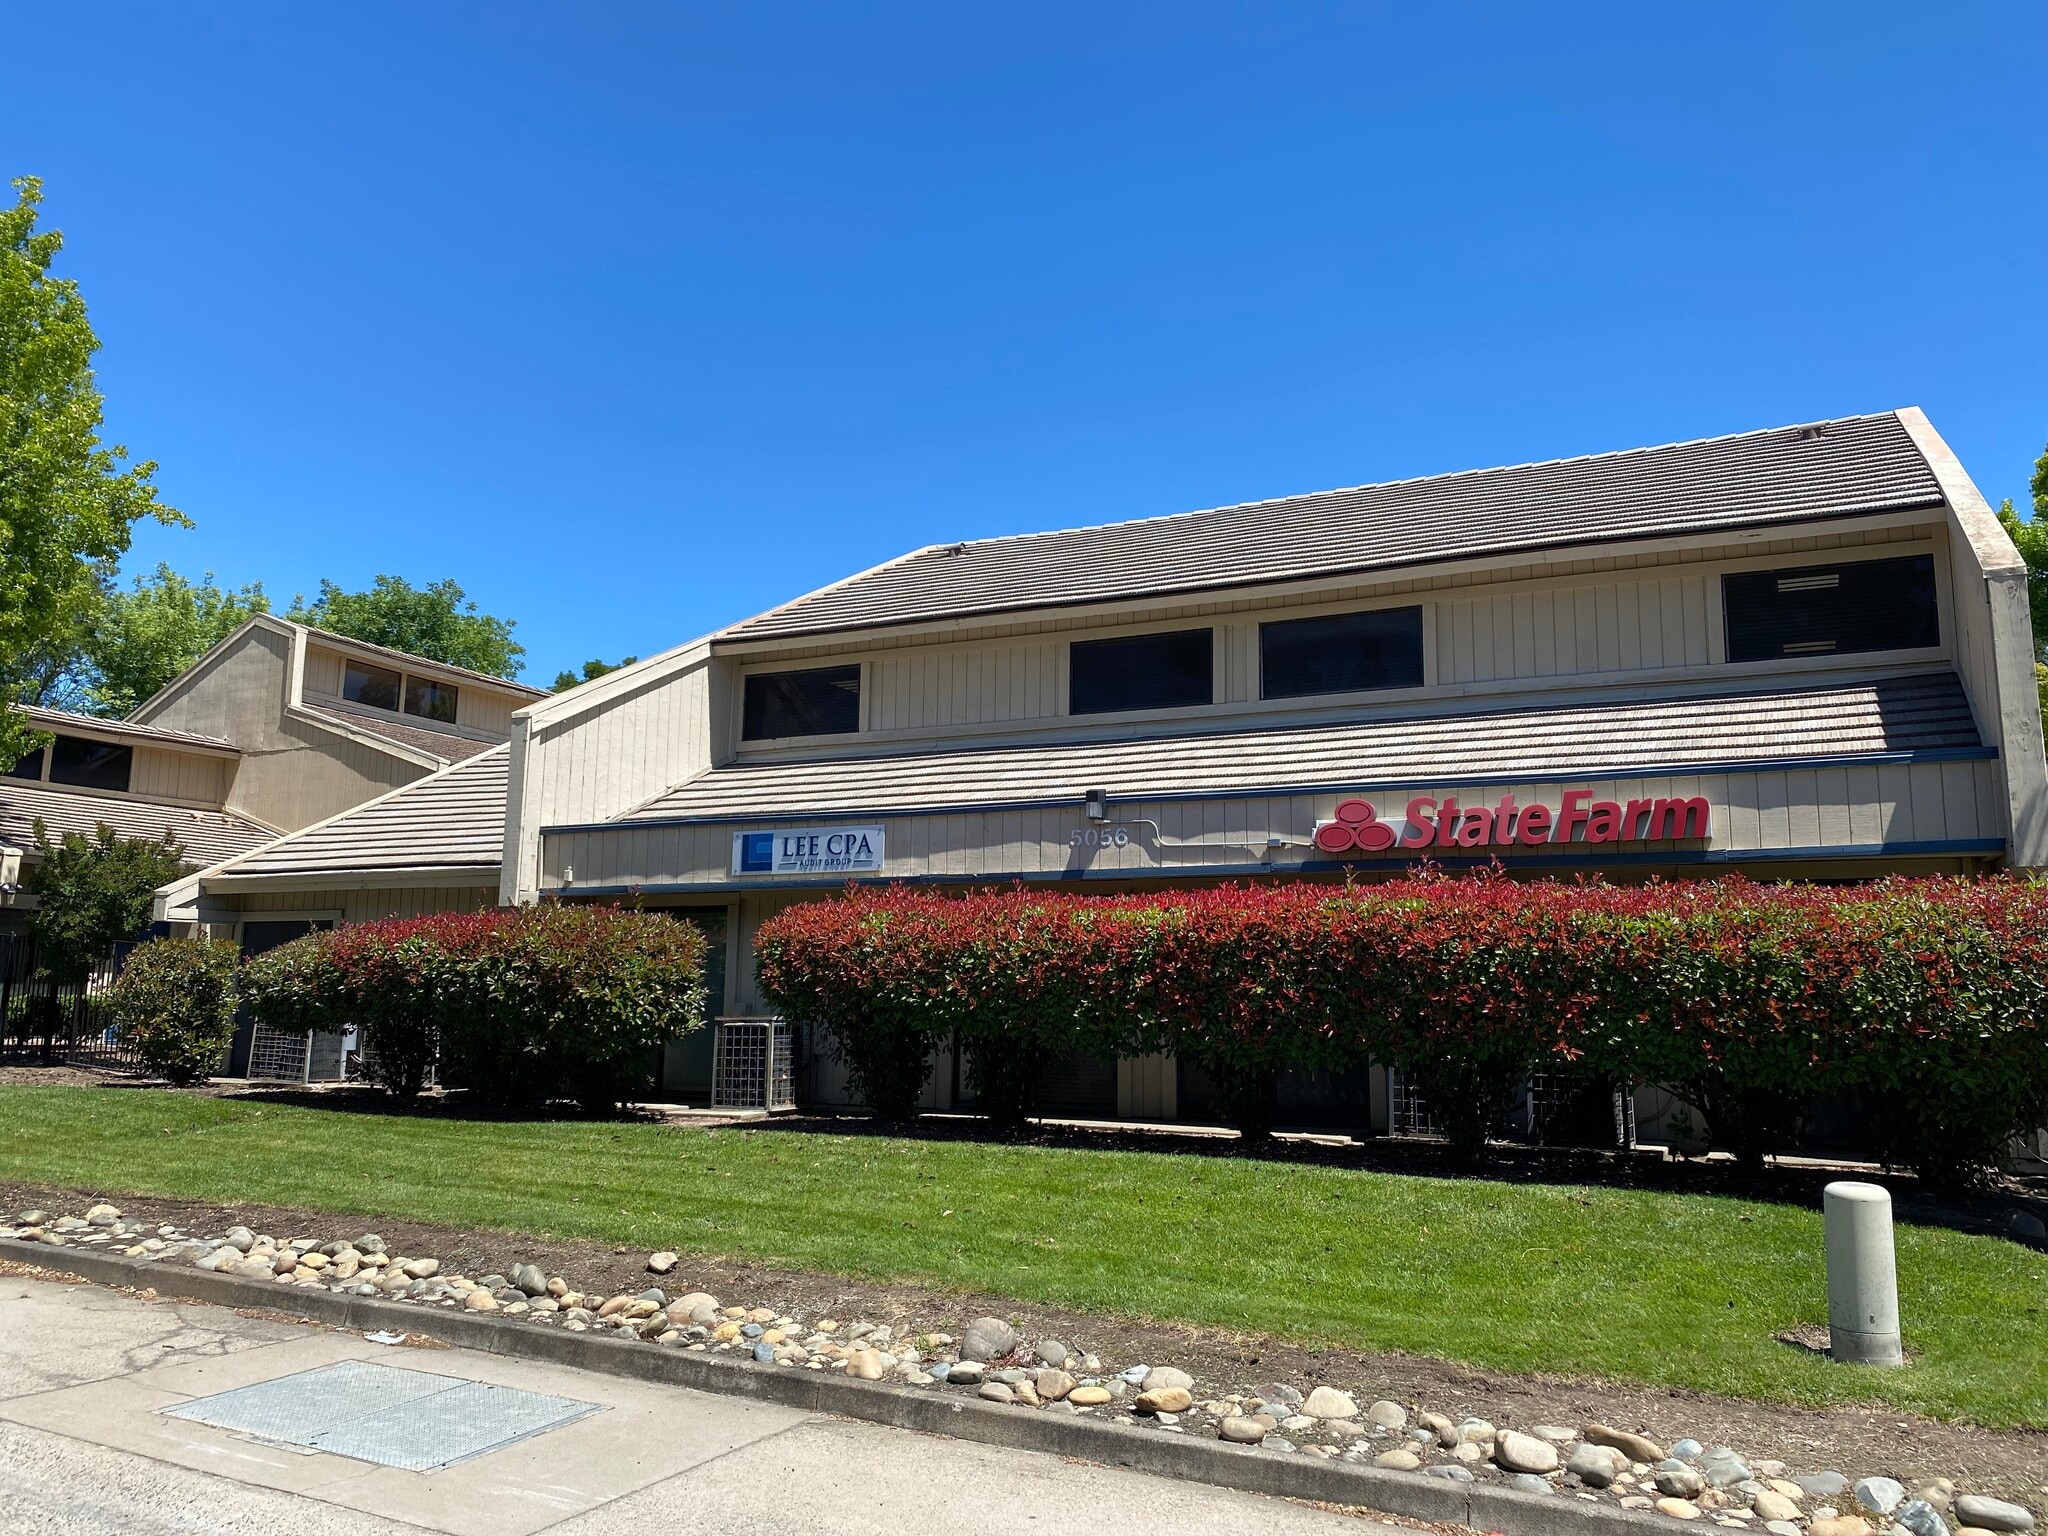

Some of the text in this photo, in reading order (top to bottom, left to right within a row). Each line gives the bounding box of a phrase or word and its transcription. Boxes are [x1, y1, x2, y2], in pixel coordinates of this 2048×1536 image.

[783, 833, 873, 857] LEE CPA
[1069, 827, 1129, 847] 5056
[799, 858, 852, 867] AUDIT GROUP
